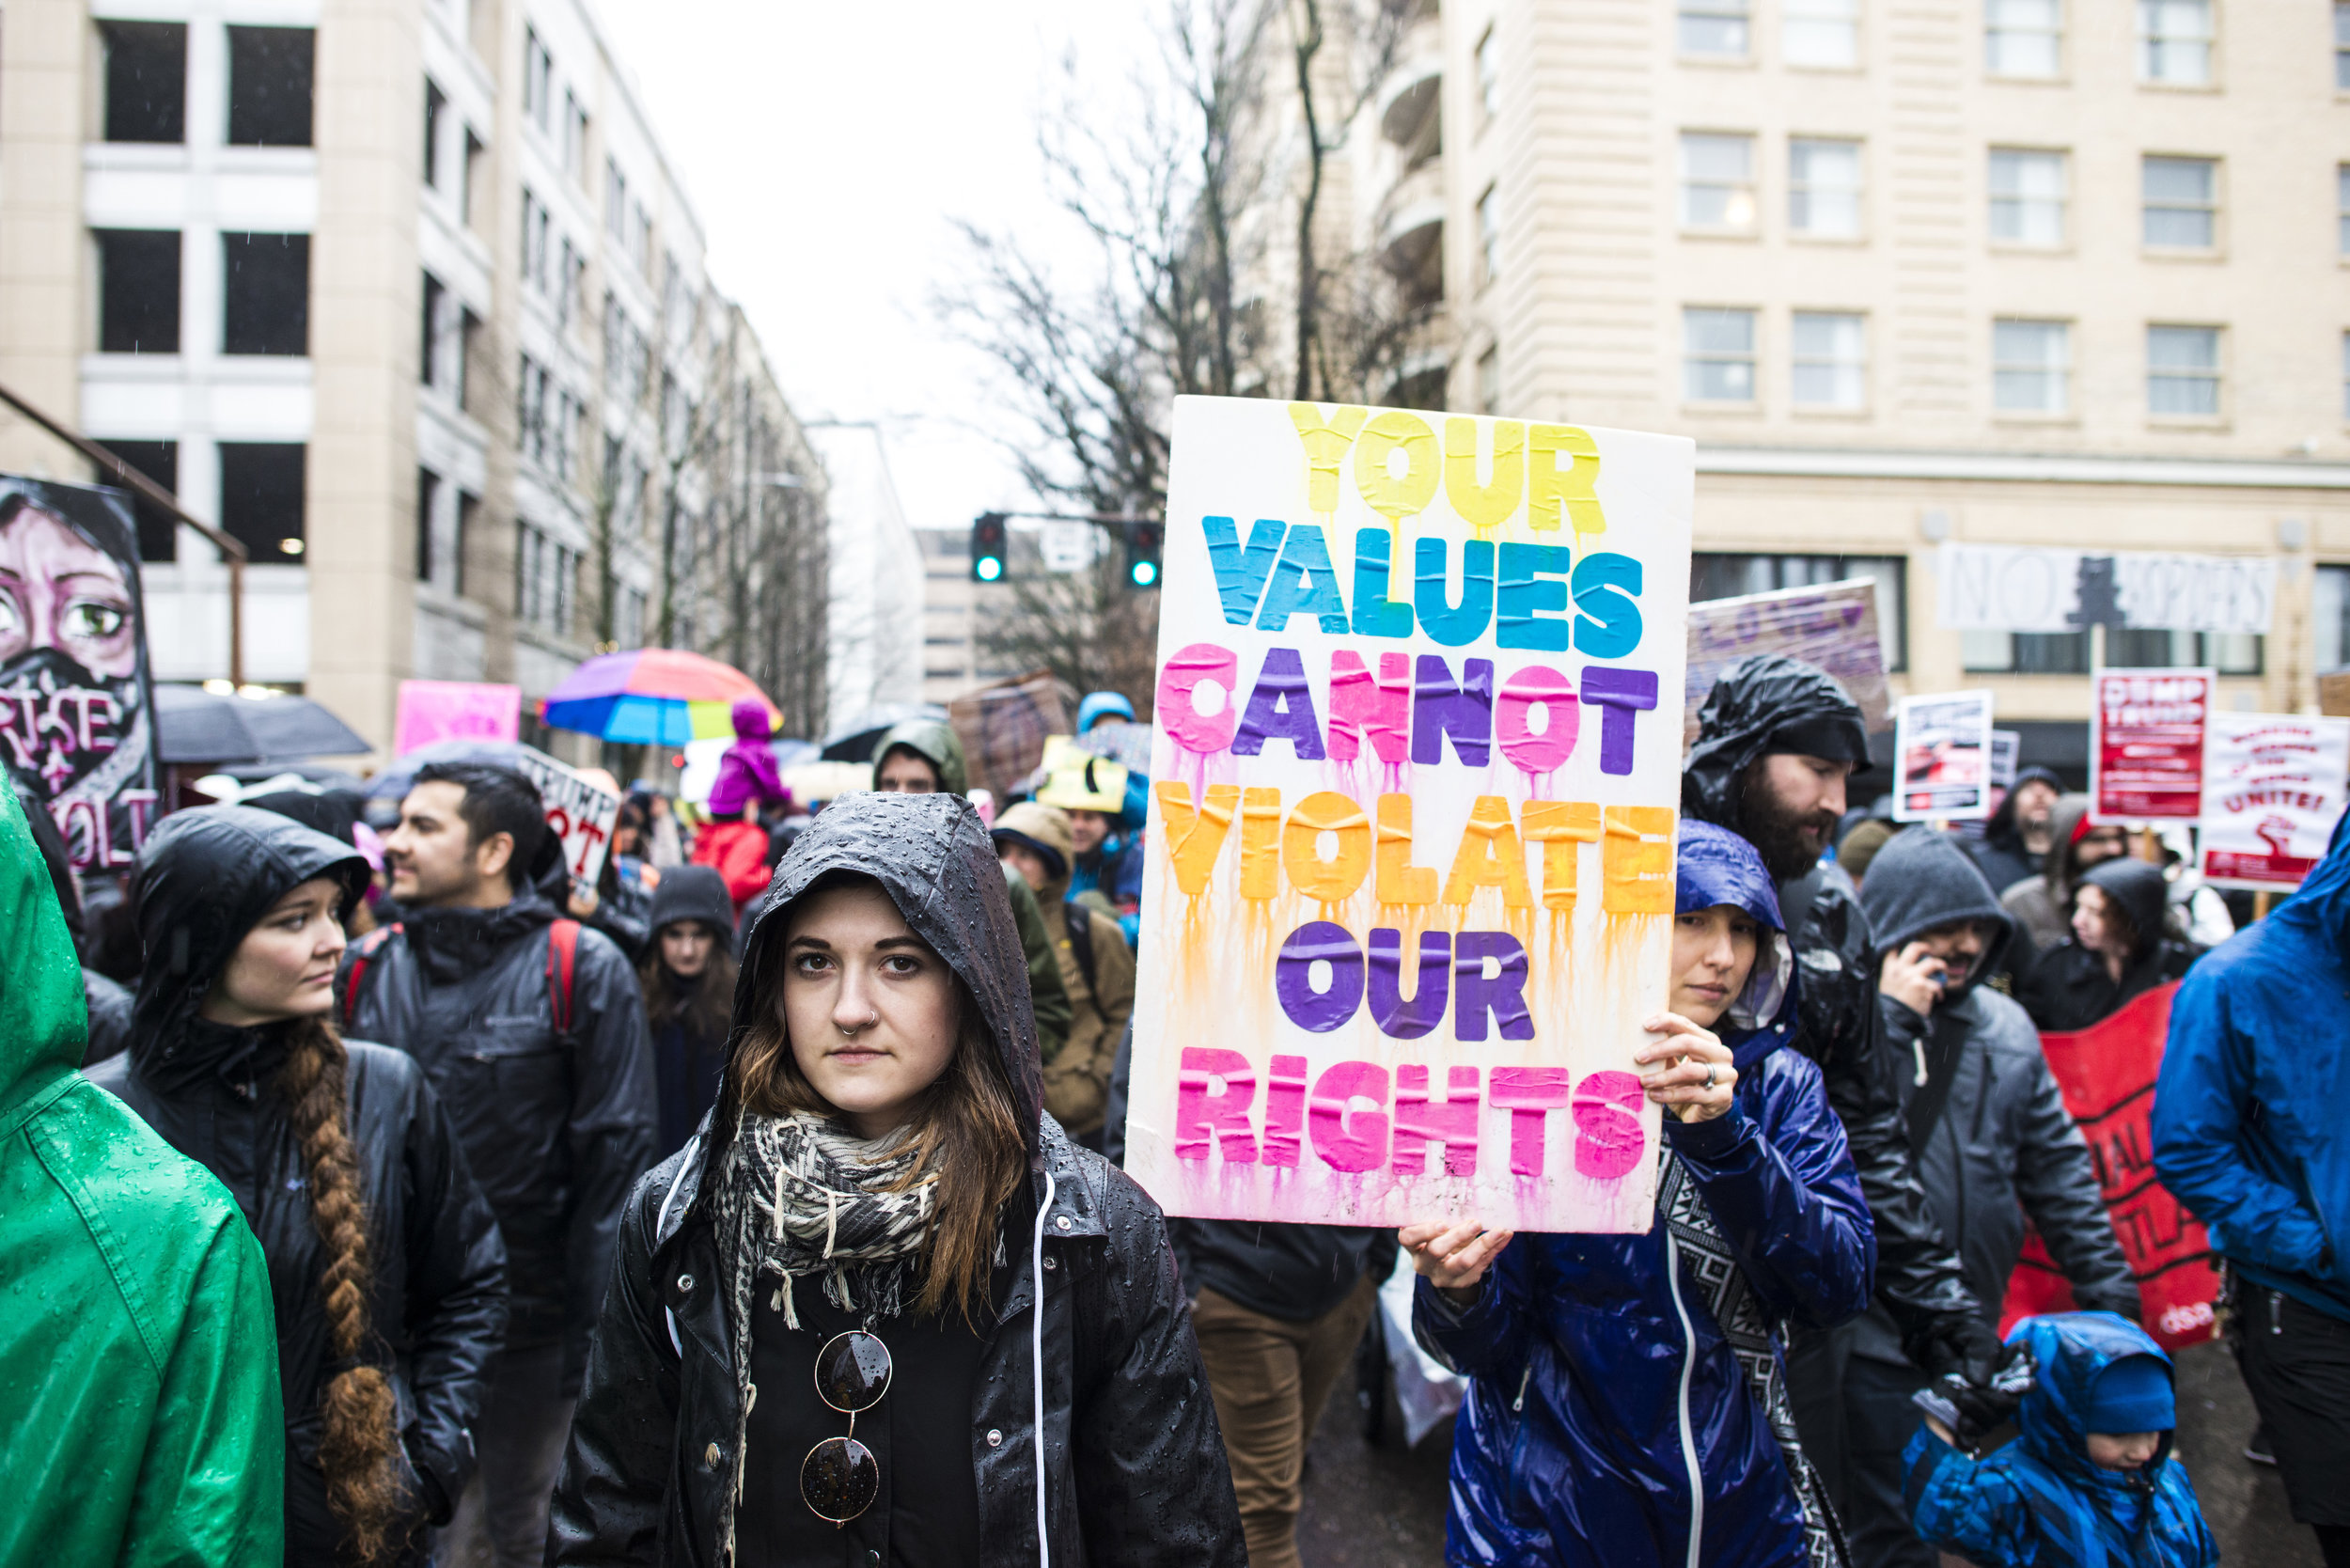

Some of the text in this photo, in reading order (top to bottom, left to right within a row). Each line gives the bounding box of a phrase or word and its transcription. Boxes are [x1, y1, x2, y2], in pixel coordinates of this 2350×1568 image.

[1288, 401, 1606, 534] YOUR
[1201, 516, 1642, 659] VALUES
[1157, 643, 1659, 776] CANNOT
[2105, 679, 2204, 704] DUMP
[2106, 703, 2202, 725] TRUMP
[1155, 781, 1675, 914] VIOLATE
[2223, 790, 2325, 813] UNITE!
[1276, 920, 1535, 1042] OUR
[1175, 1046, 1644, 1179] RIGHTS
